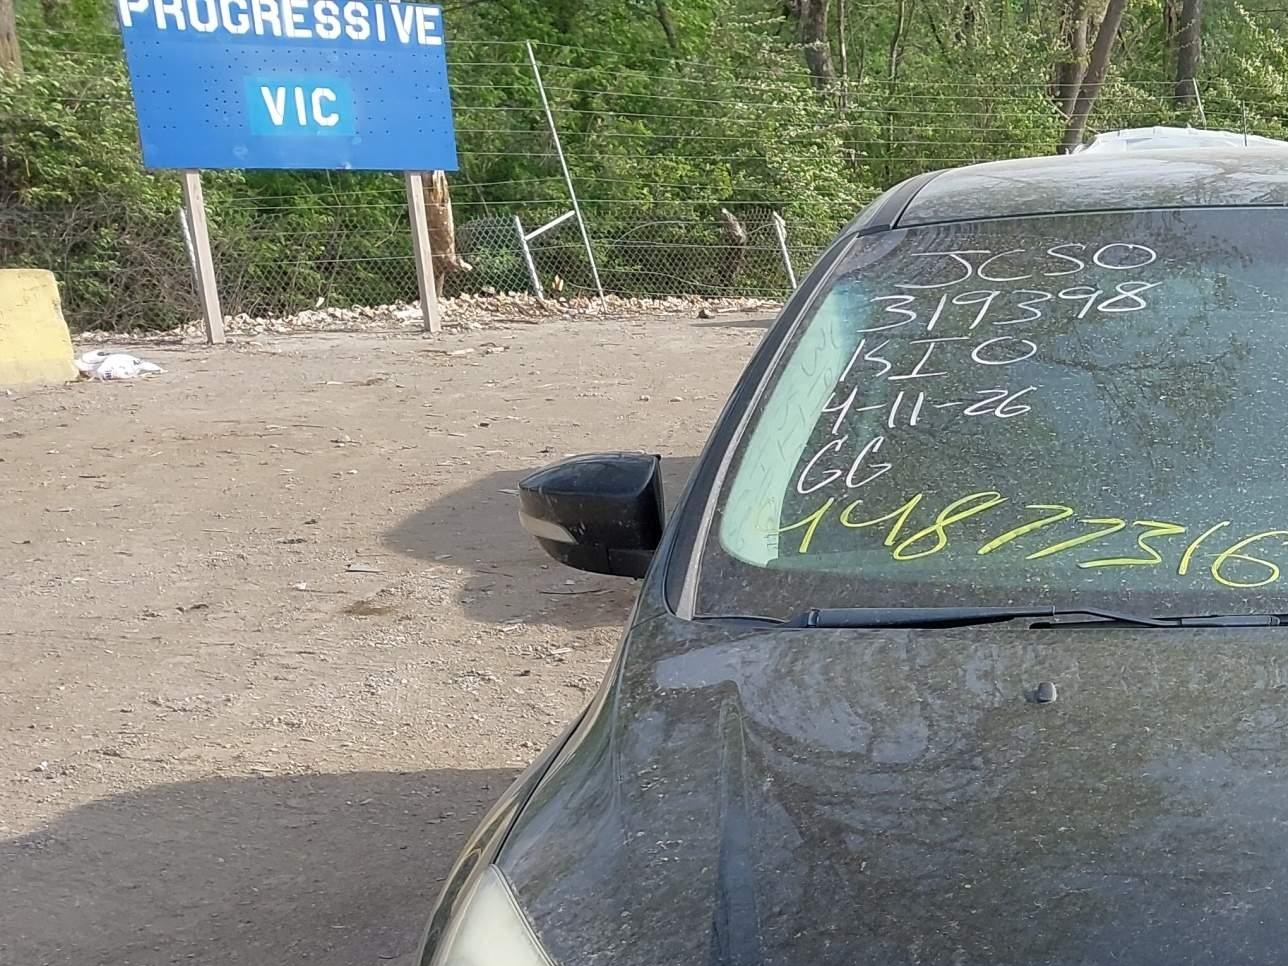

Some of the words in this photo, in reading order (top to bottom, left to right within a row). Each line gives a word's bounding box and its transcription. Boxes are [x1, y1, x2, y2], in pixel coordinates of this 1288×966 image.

[118, 0, 442, 45] PROGRESSIVE
[260, 86, 340, 126] VIC
[894, 243, 1157, 288] JCSO
[856, 281, 1163, 332] 319398
[820, 385, 1038, 435] 4-11-26
